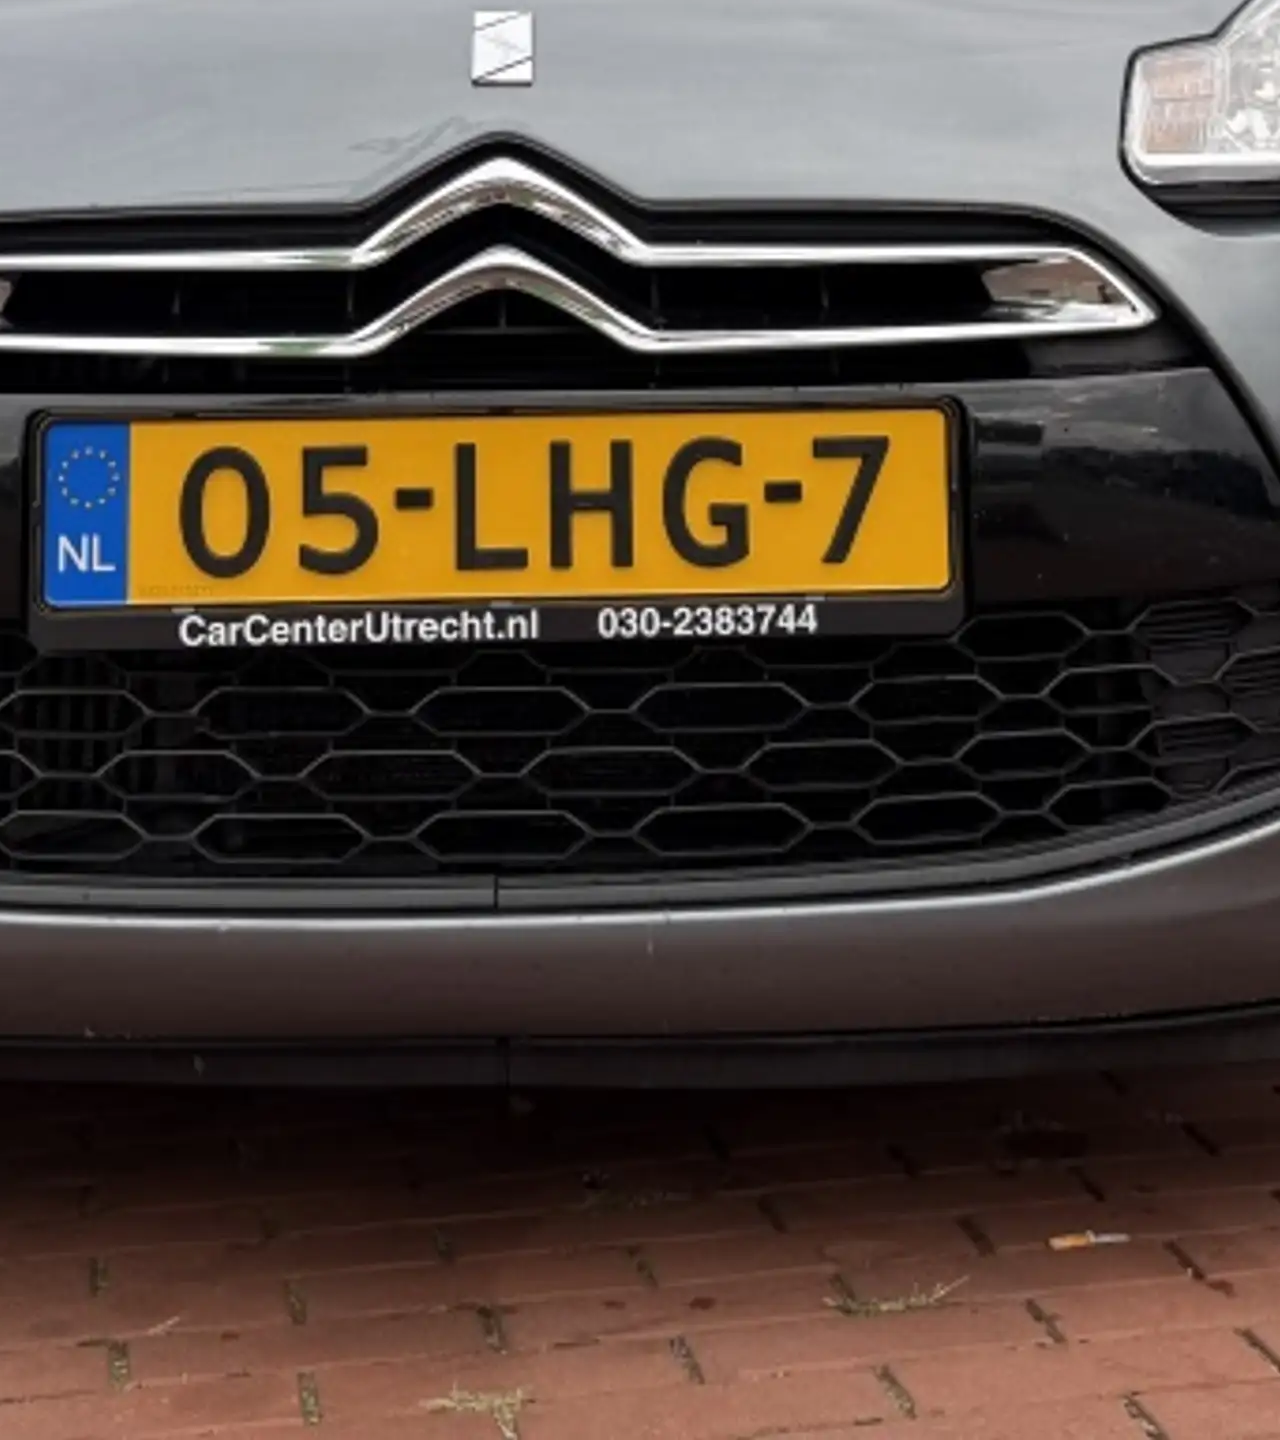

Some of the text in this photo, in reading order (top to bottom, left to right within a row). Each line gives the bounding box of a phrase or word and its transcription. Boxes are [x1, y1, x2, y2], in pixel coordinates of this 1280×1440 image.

[178, 435, 890, 579] 05-LHG-7
[57, 533, 116, 573] NL
[178, 603, 818, 647] CarCenterUtrecht.nl 030-2383744
